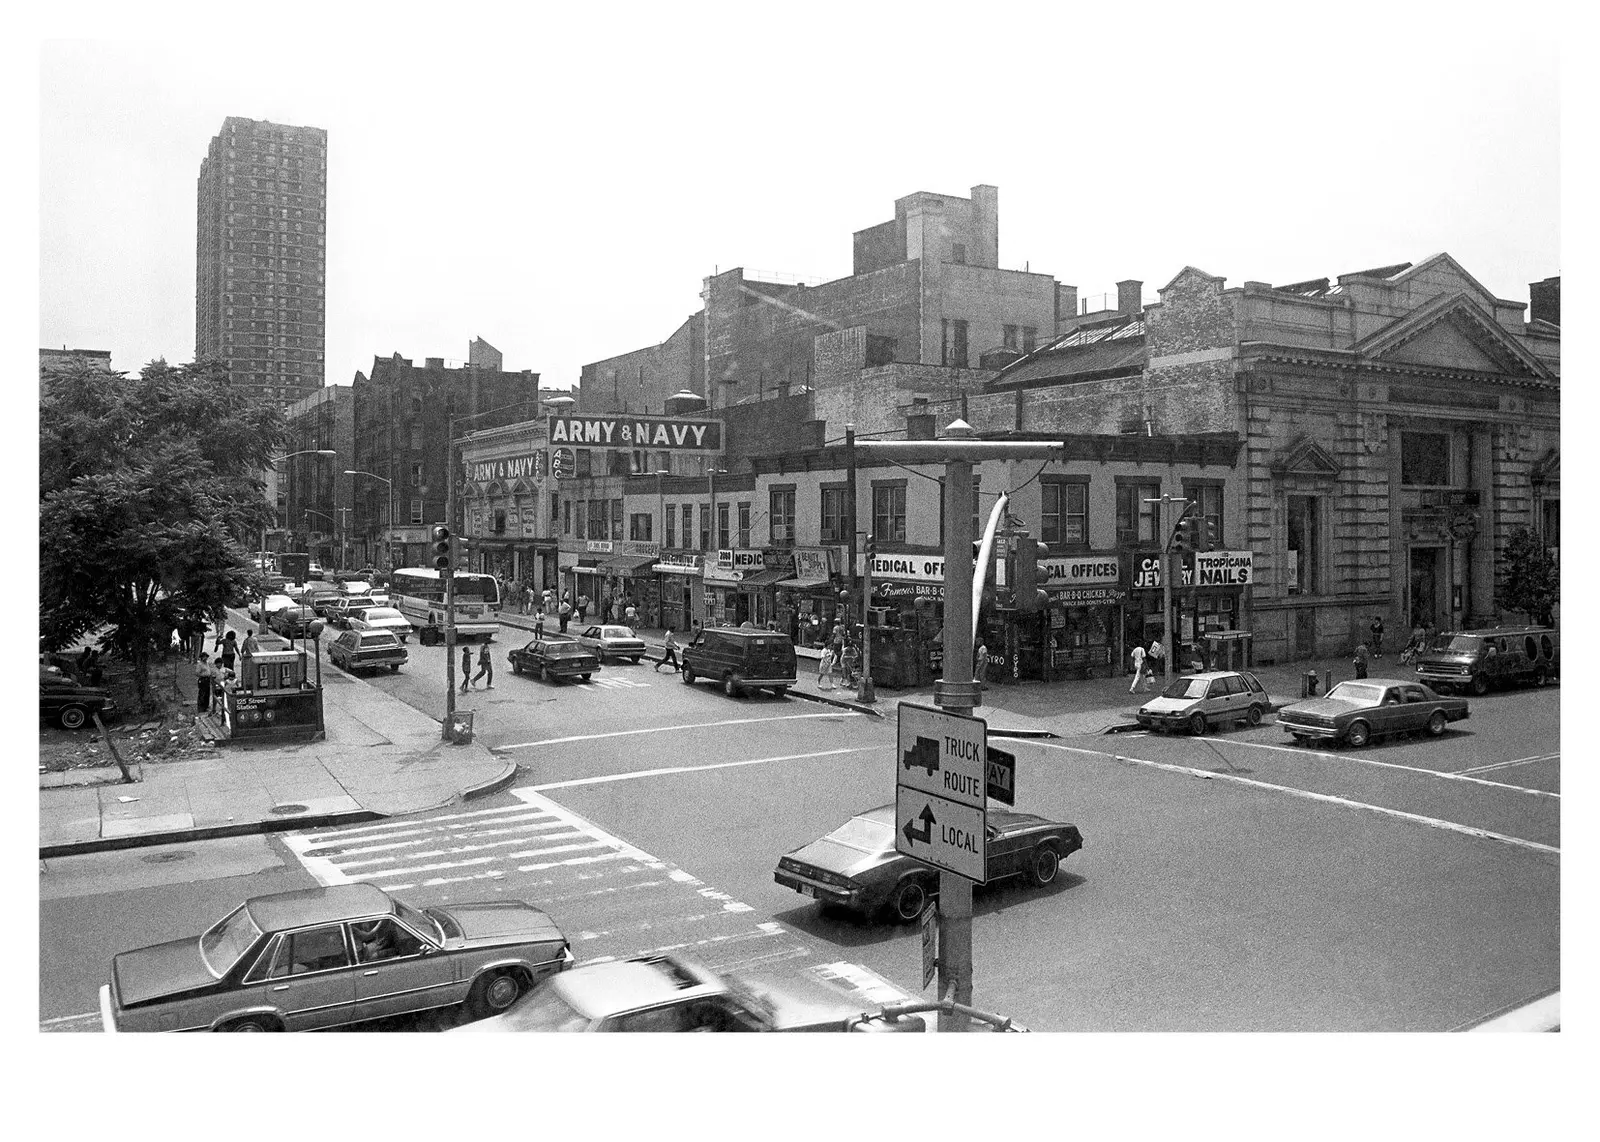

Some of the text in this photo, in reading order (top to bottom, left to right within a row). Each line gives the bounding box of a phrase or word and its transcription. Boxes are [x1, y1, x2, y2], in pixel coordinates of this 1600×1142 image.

[552, 419, 707, 446] ARMY & NAVY
[473, 462, 497, 481] ARMY
[499, 462, 504, 477] &
[507, 457, 534, 478] NAVY
[1071, 562, 1117, 578] OFFICES
[1198, 557, 1252, 568] TROPICANA
[1200, 568, 1249, 585] NAILS
[880, 582, 914, 598] Famous
[1082, 589, 1107, 599] CHICKEN
[944, 735, 980, 762] TRUCK
[944, 770, 980, 798] ROUTE
[987, 764, 1006, 786] AY
[942, 824, 979, 854] LOCAL
